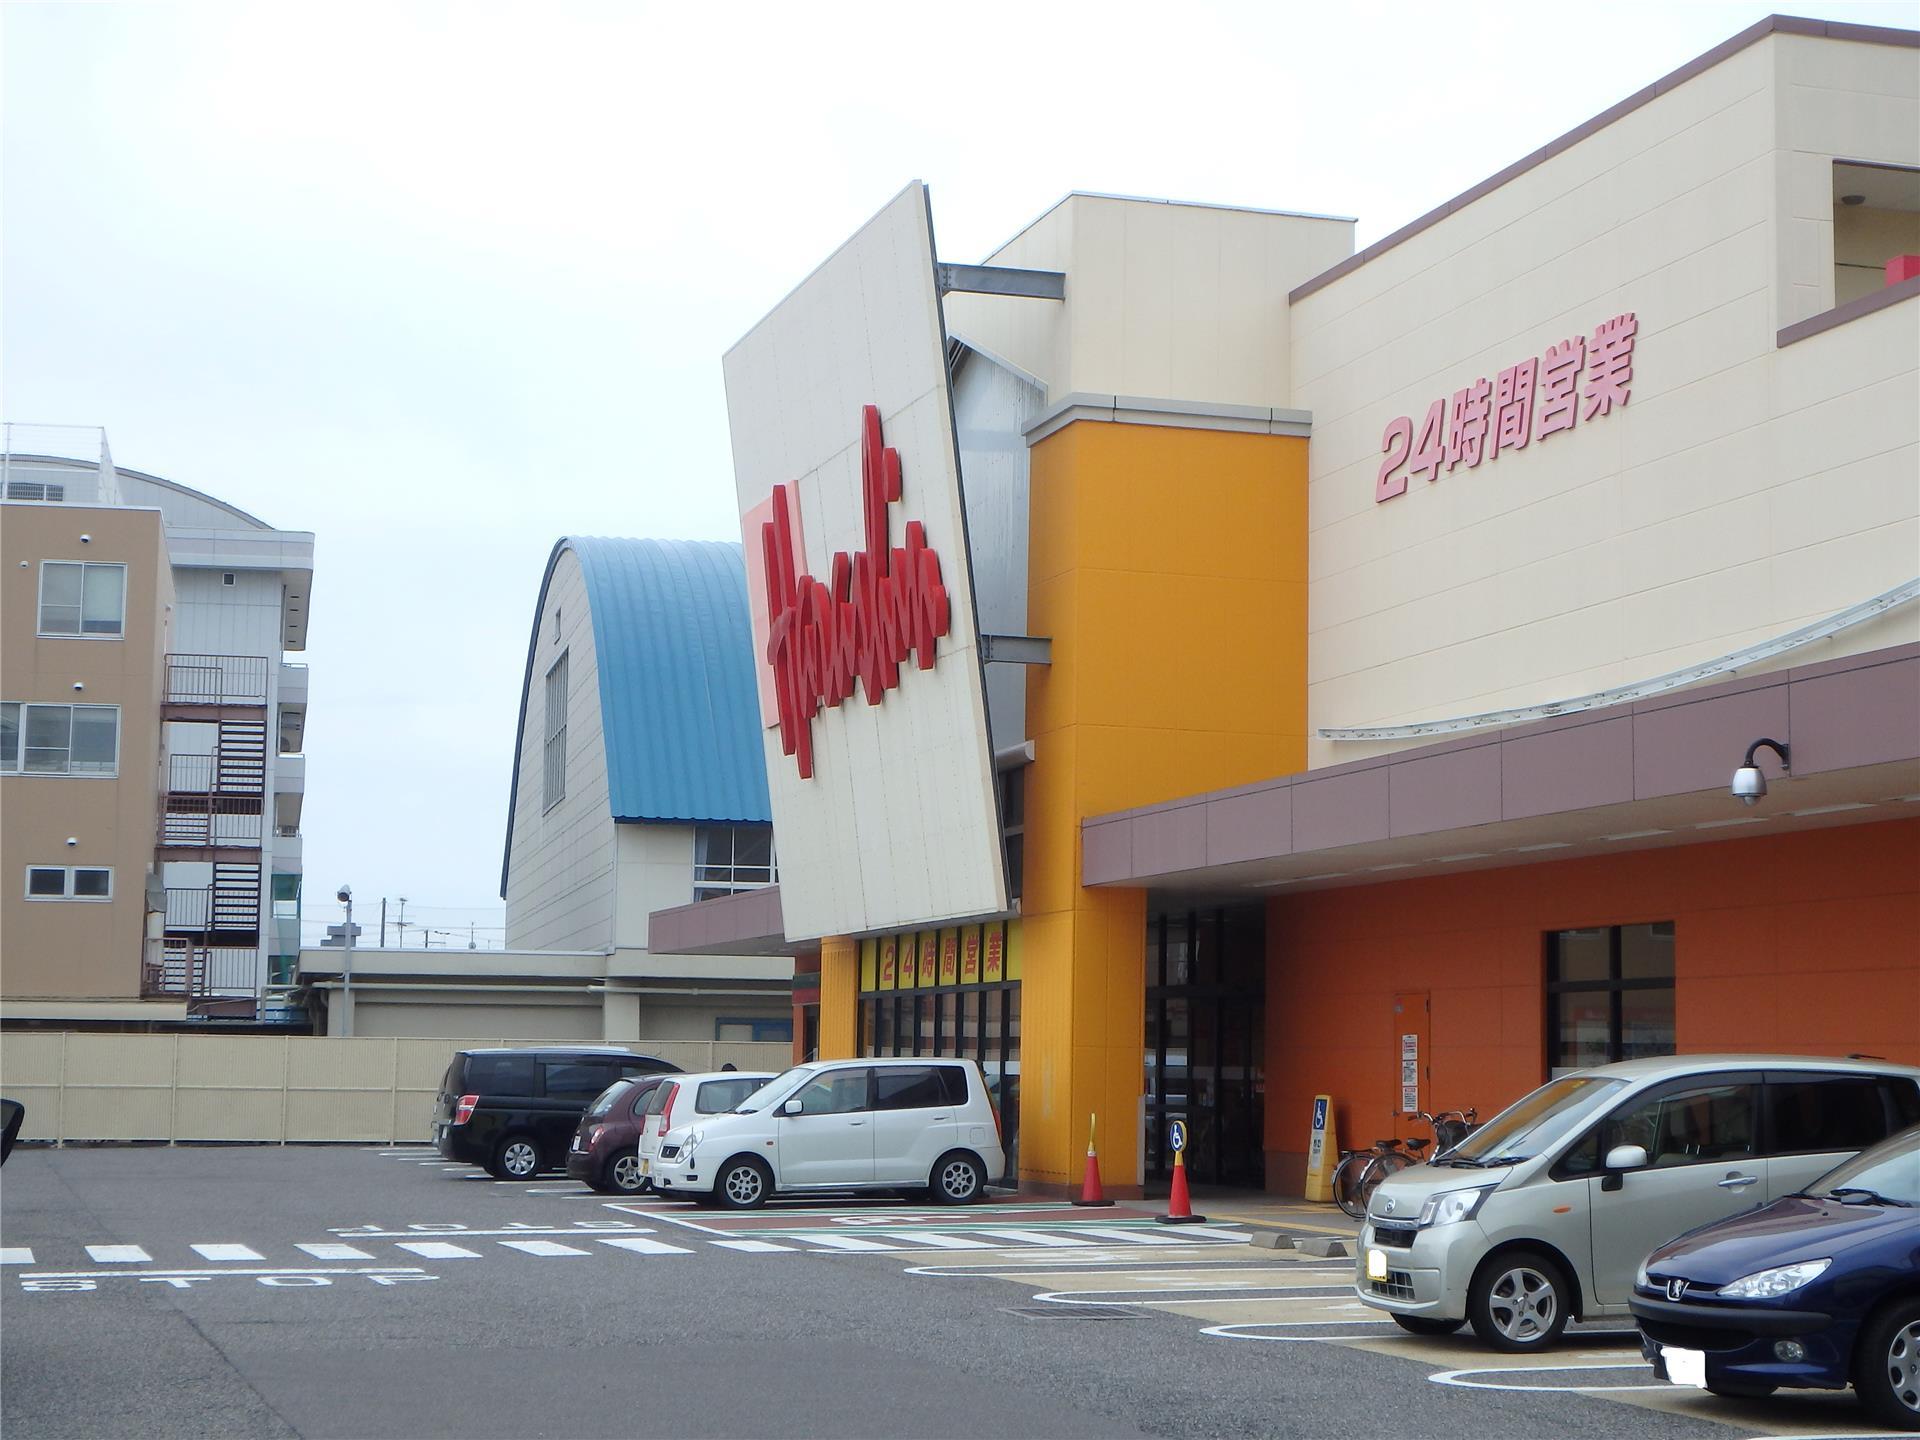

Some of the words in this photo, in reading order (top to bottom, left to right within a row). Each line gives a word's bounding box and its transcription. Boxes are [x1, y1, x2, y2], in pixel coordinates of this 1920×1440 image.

[1375, 312, 1639, 503] 24時間営業
[883, 931, 1003, 982] 24時間営業
[20, 1274, 440, 1291] STOP
